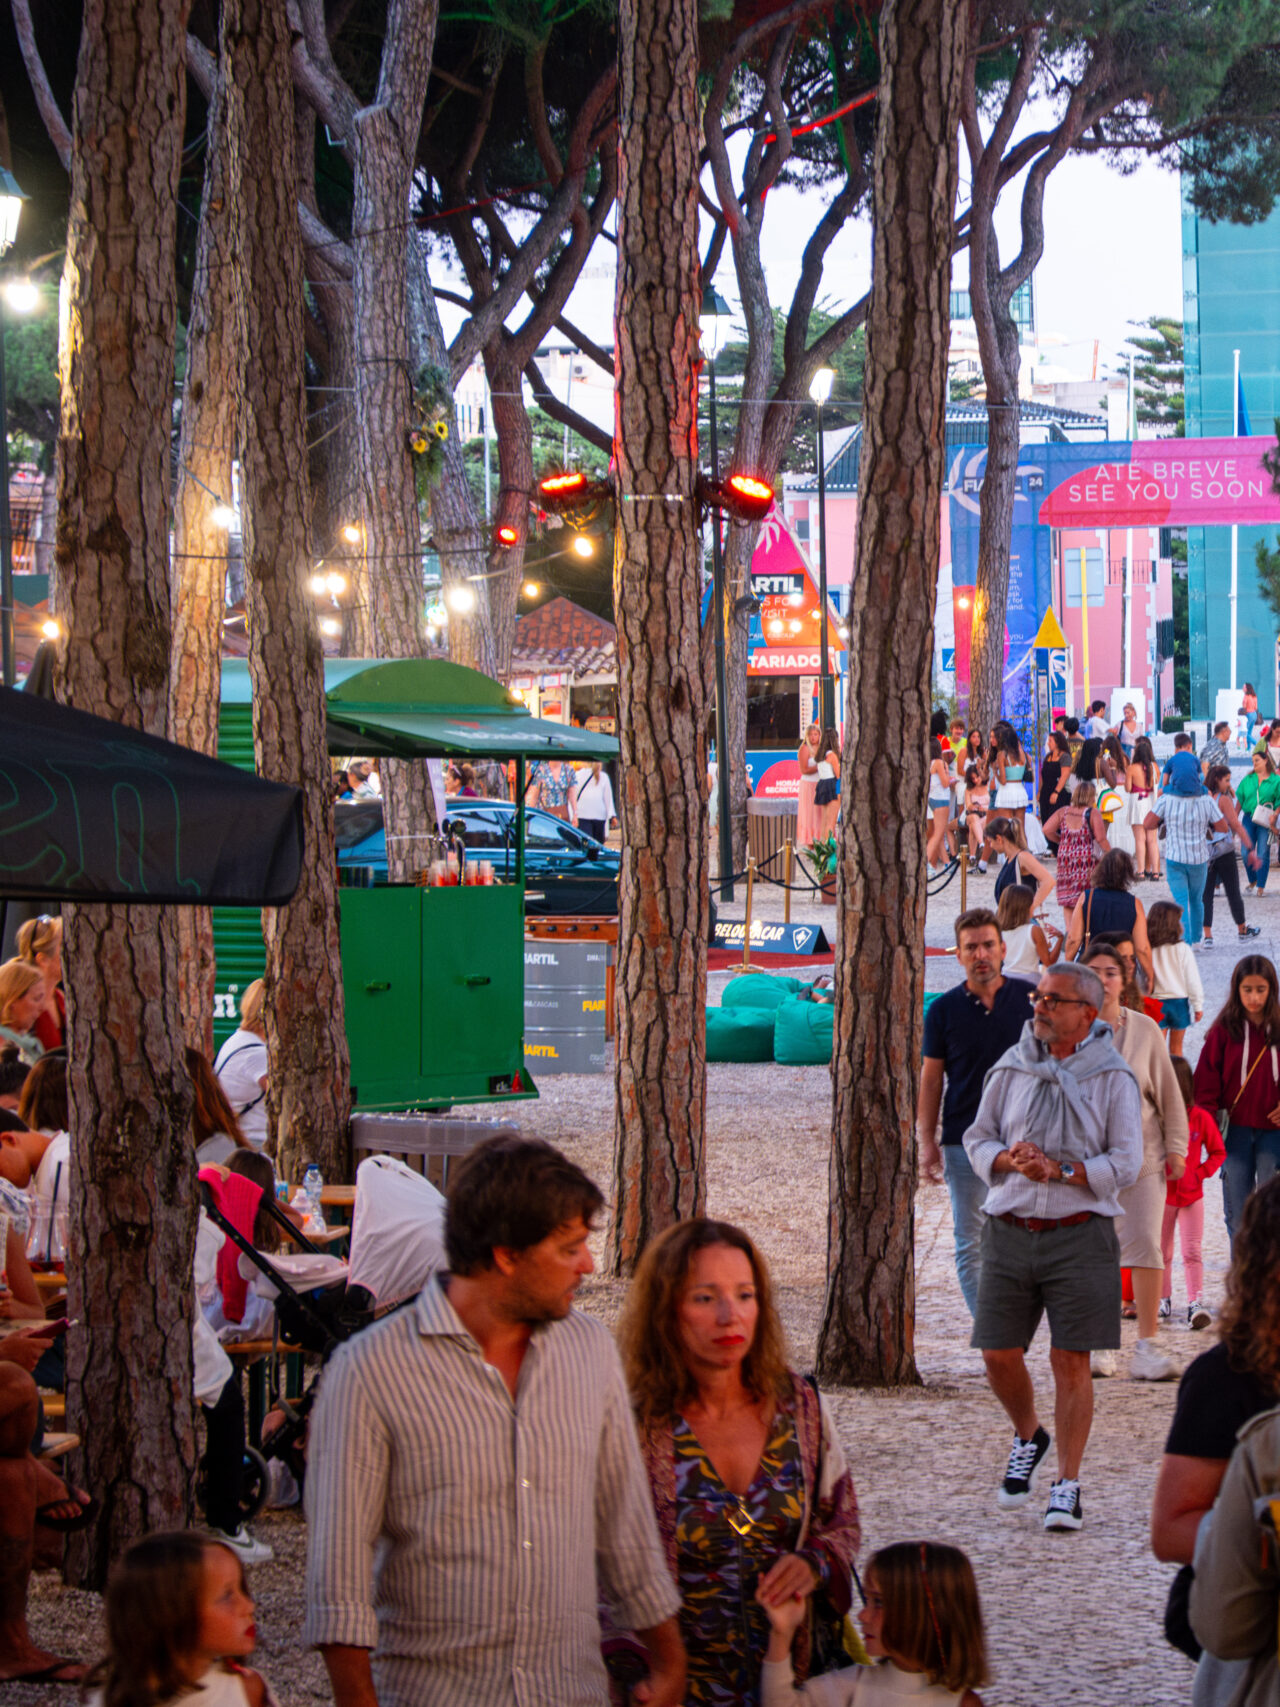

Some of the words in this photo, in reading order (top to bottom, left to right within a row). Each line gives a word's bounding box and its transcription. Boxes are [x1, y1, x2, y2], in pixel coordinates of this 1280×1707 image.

[1094, 459, 1142, 481] ATÉ
[1153, 460, 1237, 480] BREVE
[1028, 477, 1043, 487] 24
[1069, 484, 1115, 502] SEE
[1126, 482, 1179, 501] YOU
[1191, 480, 1264, 499] SOON
[1009, 633, 1024, 642] you
[748, 654, 821, 668] TARIADO
